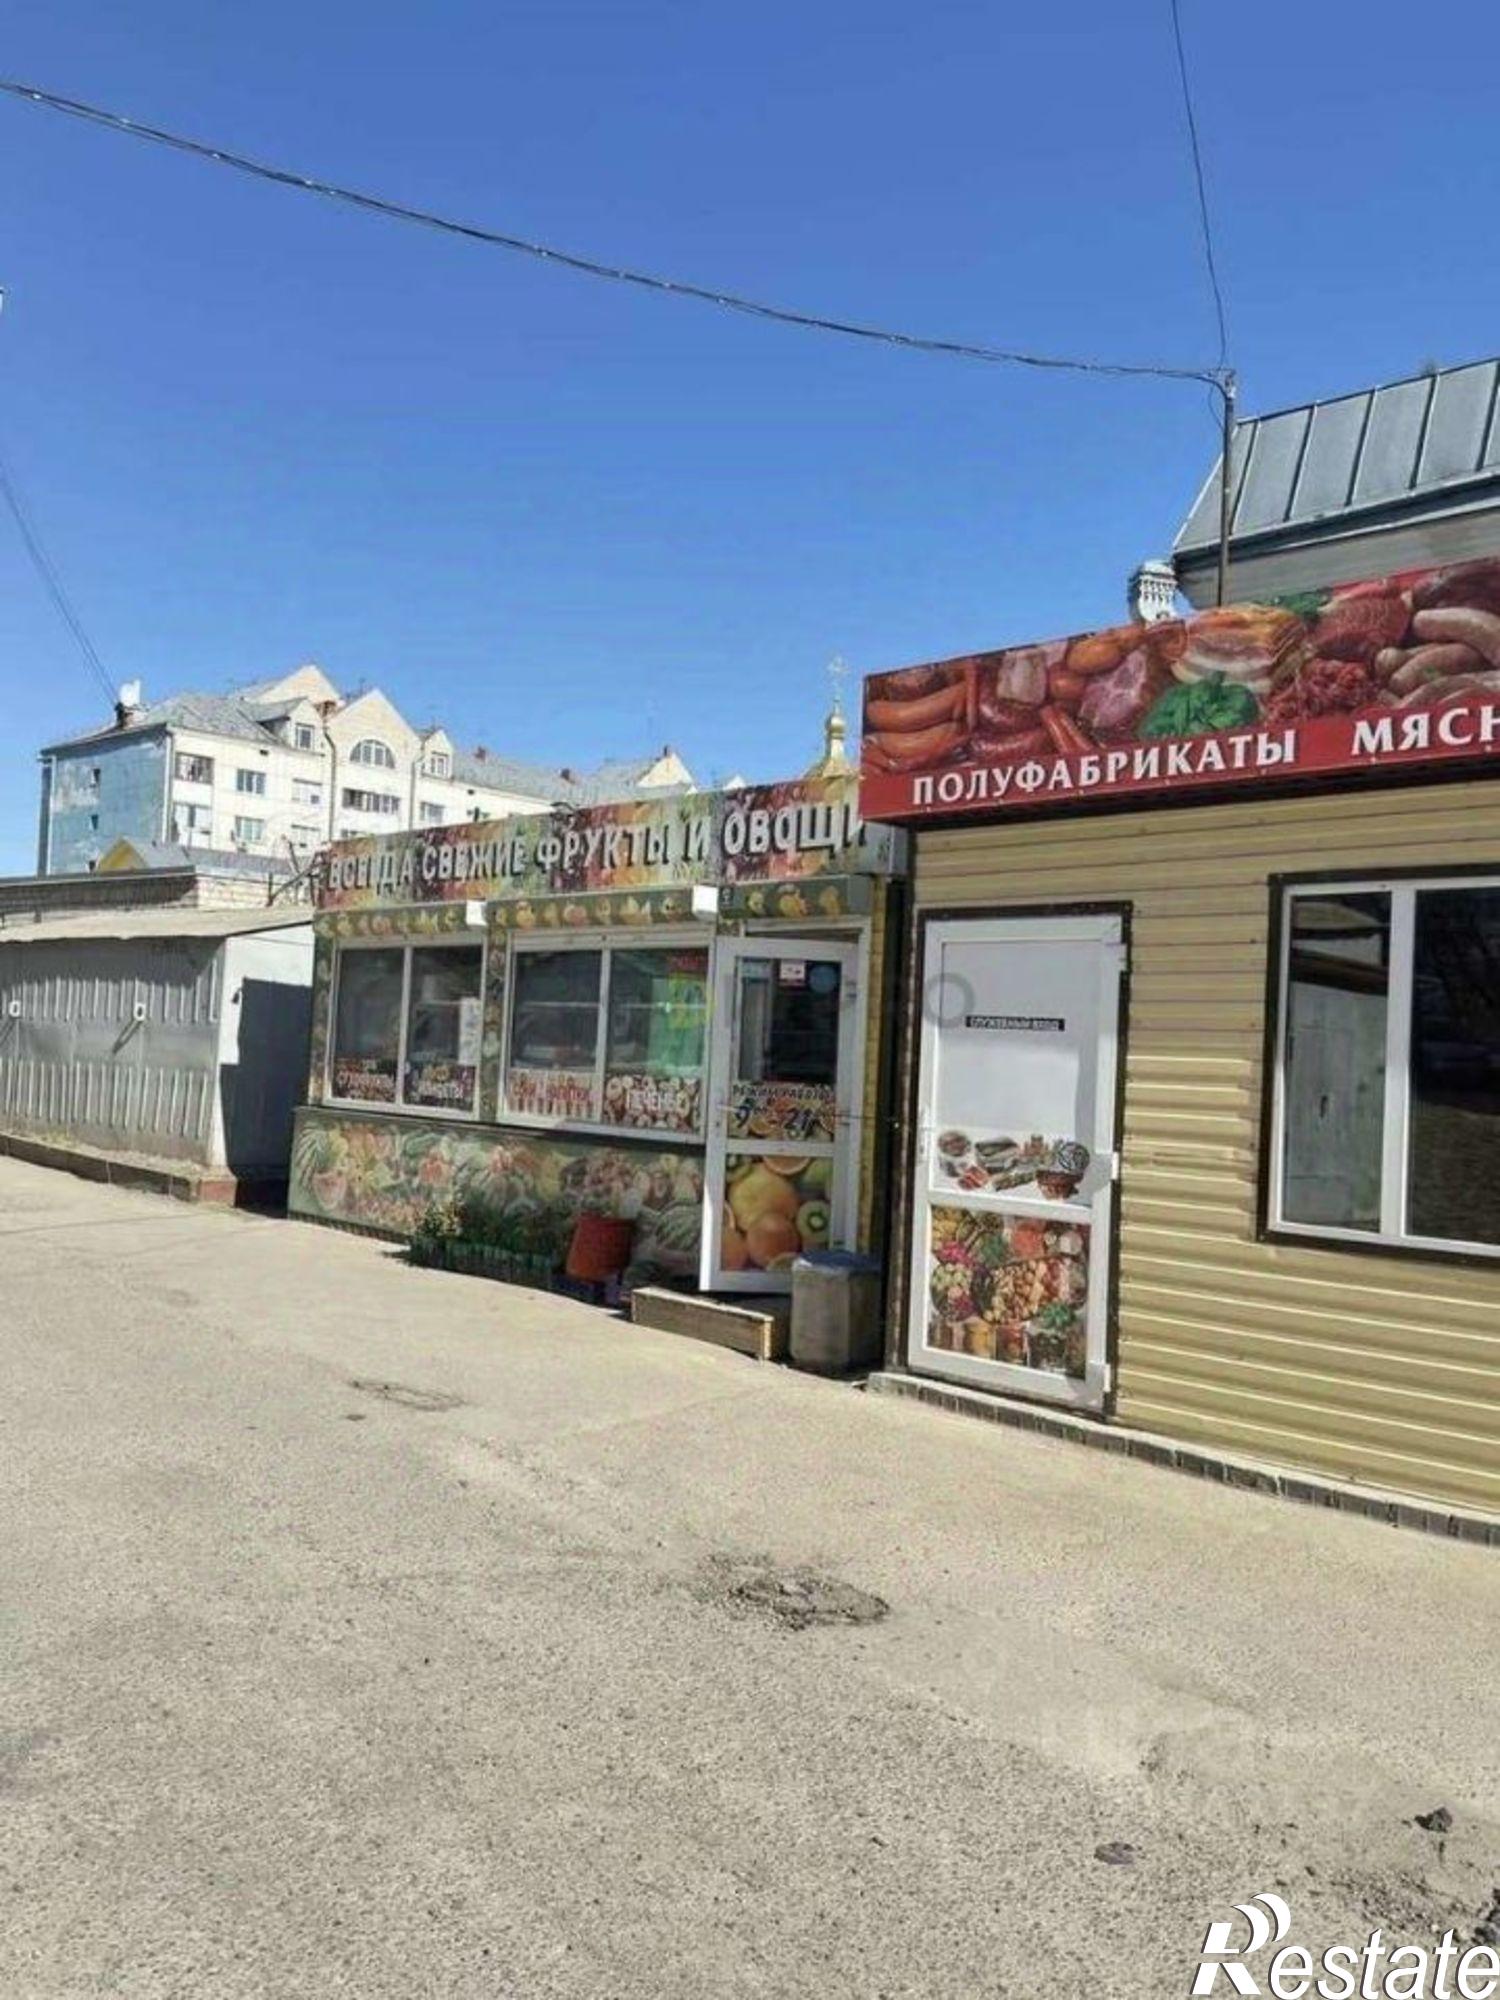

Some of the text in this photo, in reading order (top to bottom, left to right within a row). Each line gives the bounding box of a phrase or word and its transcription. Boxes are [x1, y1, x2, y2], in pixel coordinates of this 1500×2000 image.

[912, 729, 1297, 806] ПОЛУФАБРИКАТЫ
[422, 837, 528, 882] СВЕЖИЕ
[537, 823, 675, 871] ФРУКТЫ
